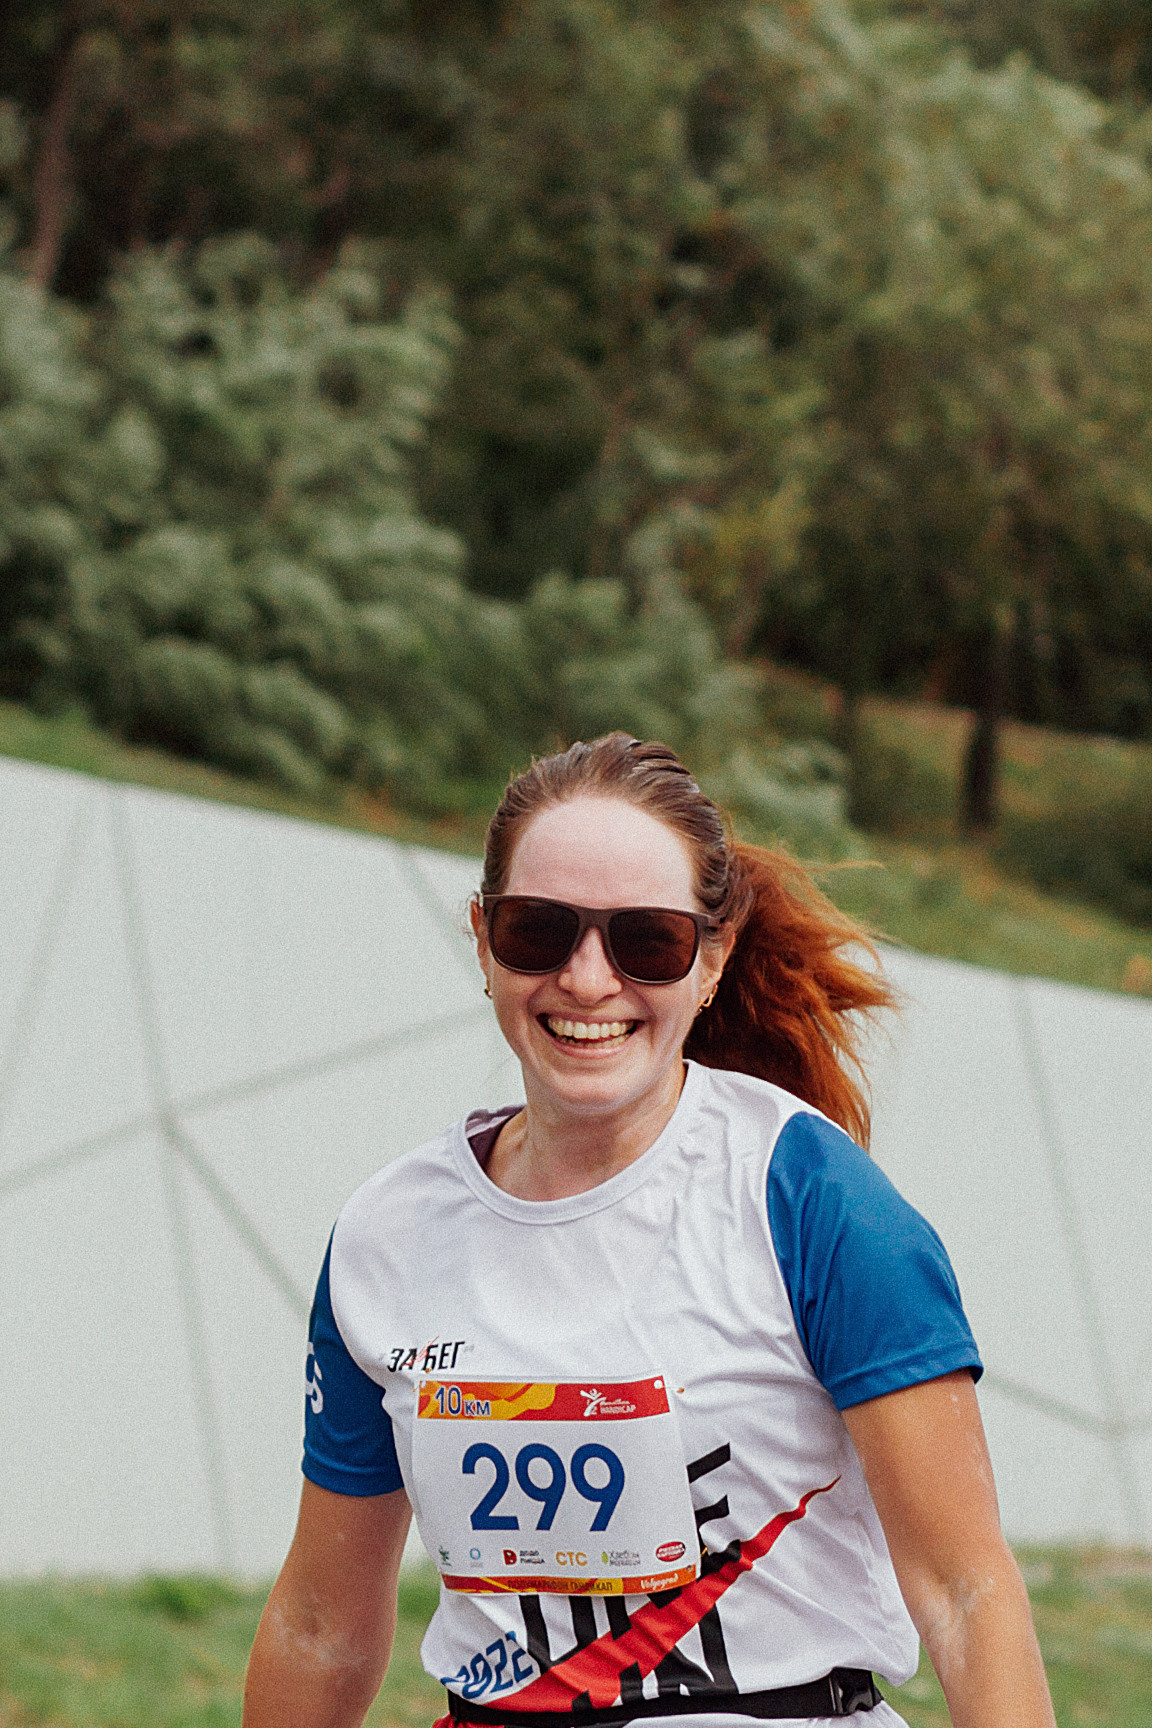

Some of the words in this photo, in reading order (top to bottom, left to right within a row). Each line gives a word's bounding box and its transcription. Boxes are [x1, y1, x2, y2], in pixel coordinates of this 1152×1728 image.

[462, 1442, 625, 1532] 299
[555, 1551, 588, 1566] СТС
[641, 1573, 679, 1591] Volgograd
